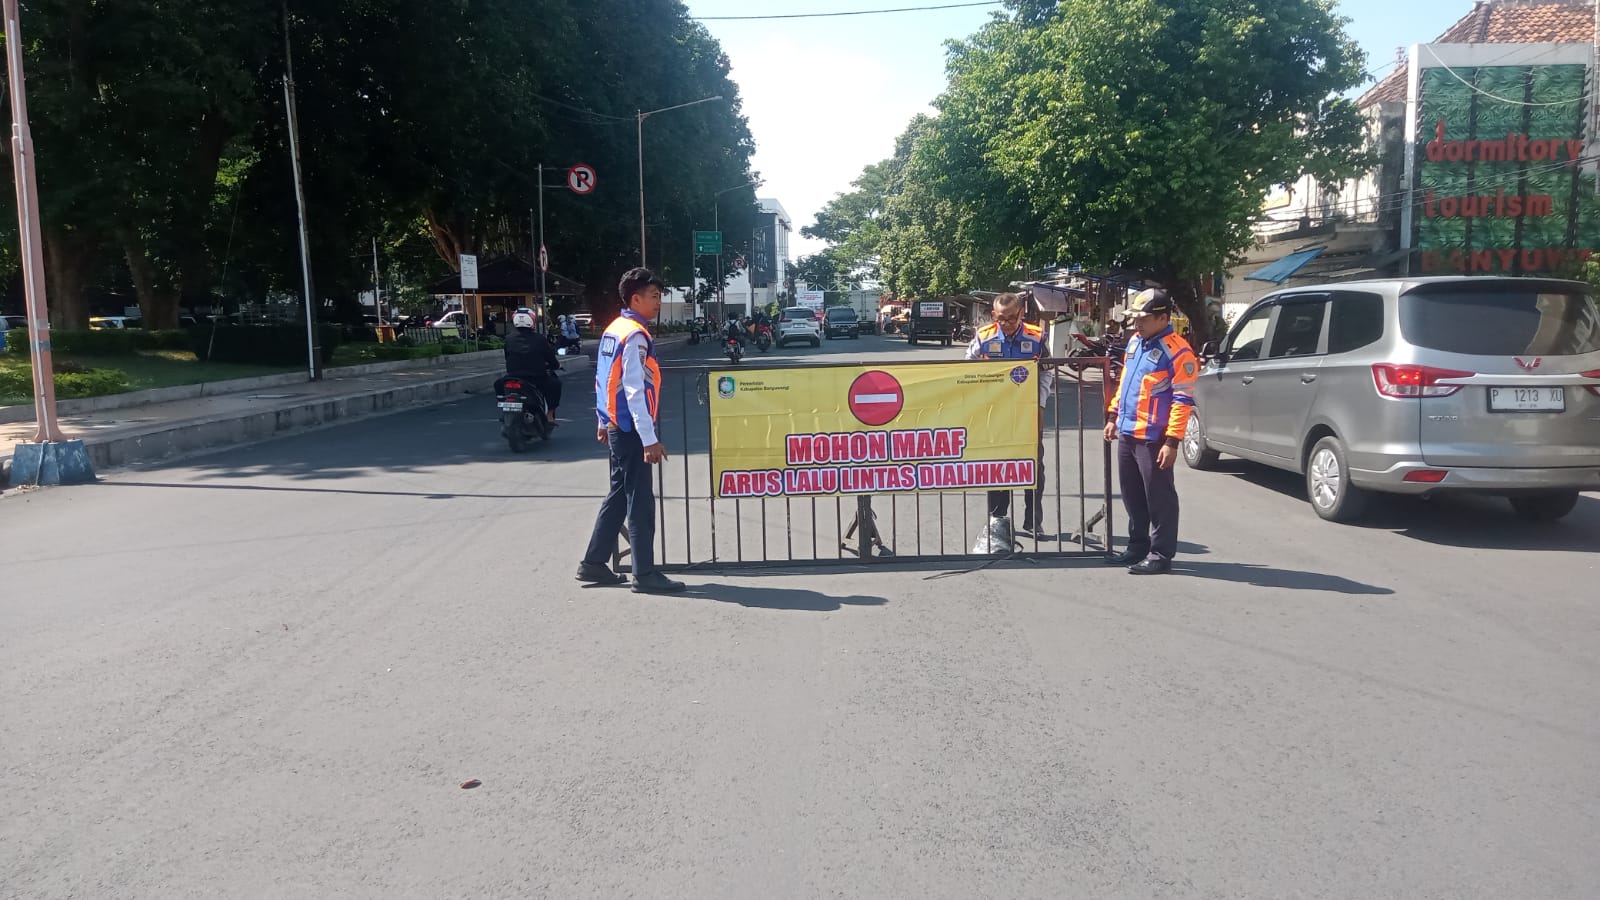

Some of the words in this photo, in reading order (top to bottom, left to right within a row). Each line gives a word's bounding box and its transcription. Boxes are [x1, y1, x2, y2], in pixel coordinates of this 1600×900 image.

[1426, 119, 1585, 167] dormitory
[1424, 189, 1553, 217] tourism
[1492, 389, 1499, 402] P
[1514, 389, 1539, 402] 1213
[786, 432, 888, 465] MOHON
[890, 428, 966, 461] MAAF
[720, 467, 782, 497] ARUS
[784, 465, 839, 494] LALU
[841, 462, 916, 492] LINTAS
[918, 460, 1034, 488] DIALIHKAN
